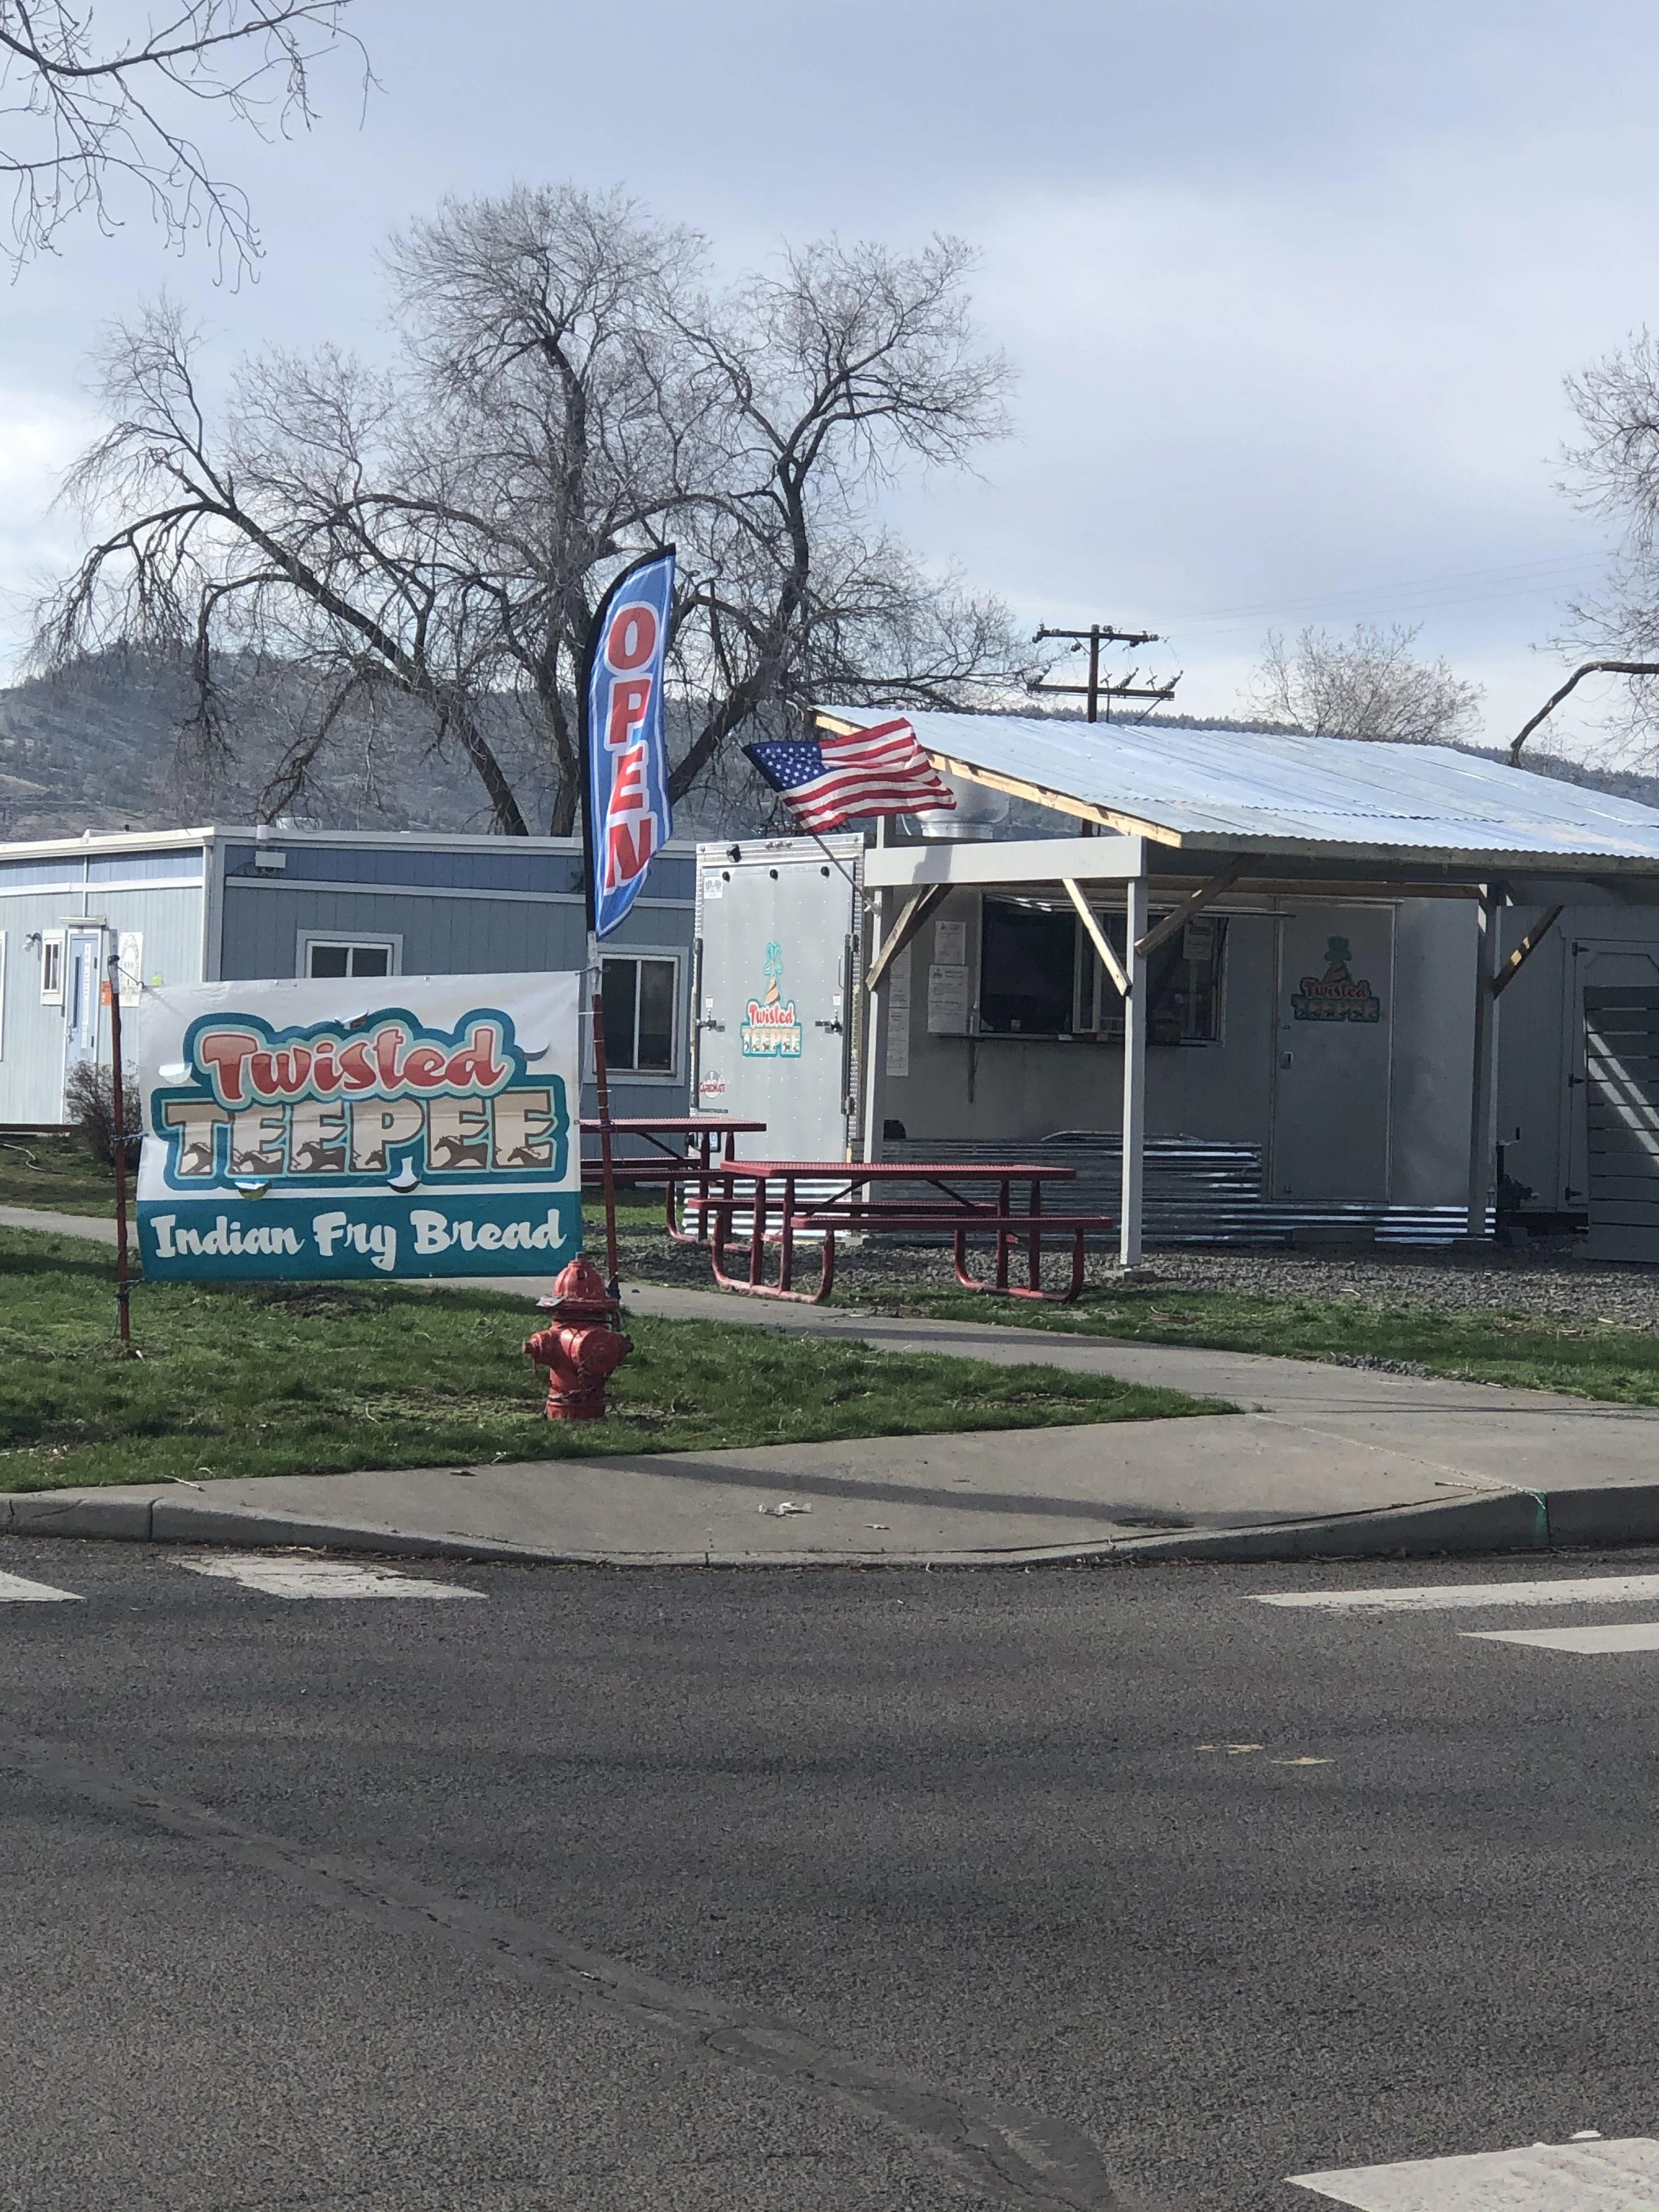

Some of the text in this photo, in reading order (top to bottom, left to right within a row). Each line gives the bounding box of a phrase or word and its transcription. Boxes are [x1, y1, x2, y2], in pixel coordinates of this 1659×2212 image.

[605, 605, 658, 890] OPEN
[749, 1003, 793, 1026] Twisted
[1304, 981, 1367, 998] Twisted
[201, 1026, 508, 1100] Twisted
[164, 1090, 555, 1176] TEEPEE
[149, 1209, 567, 1272] Indian Fry Bread
